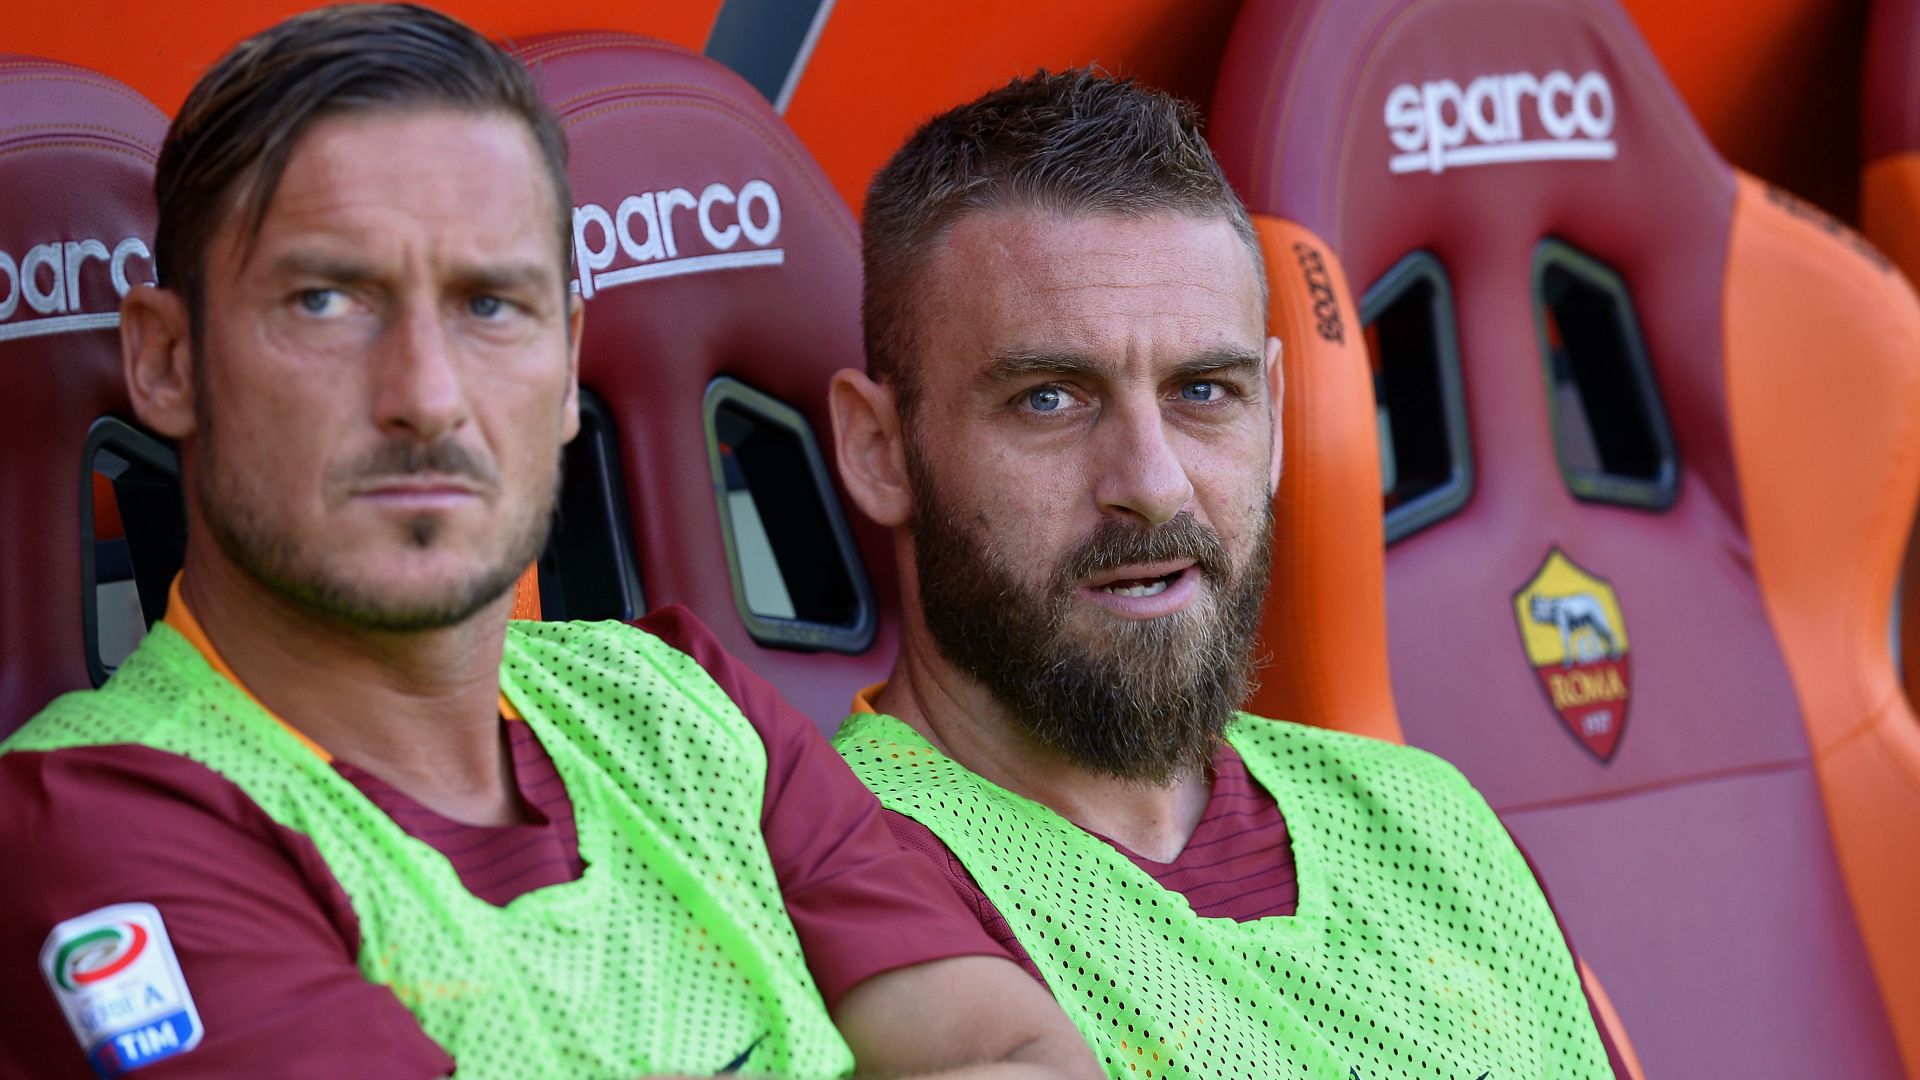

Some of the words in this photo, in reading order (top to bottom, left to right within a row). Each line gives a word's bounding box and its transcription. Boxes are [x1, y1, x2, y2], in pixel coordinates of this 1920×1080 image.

[1384, 70, 1616, 174] sparco
[571, 179, 782, 300] parco
[1549, 666, 1627, 710] ROMA
[116, 1019, 179, 1061] TIM
